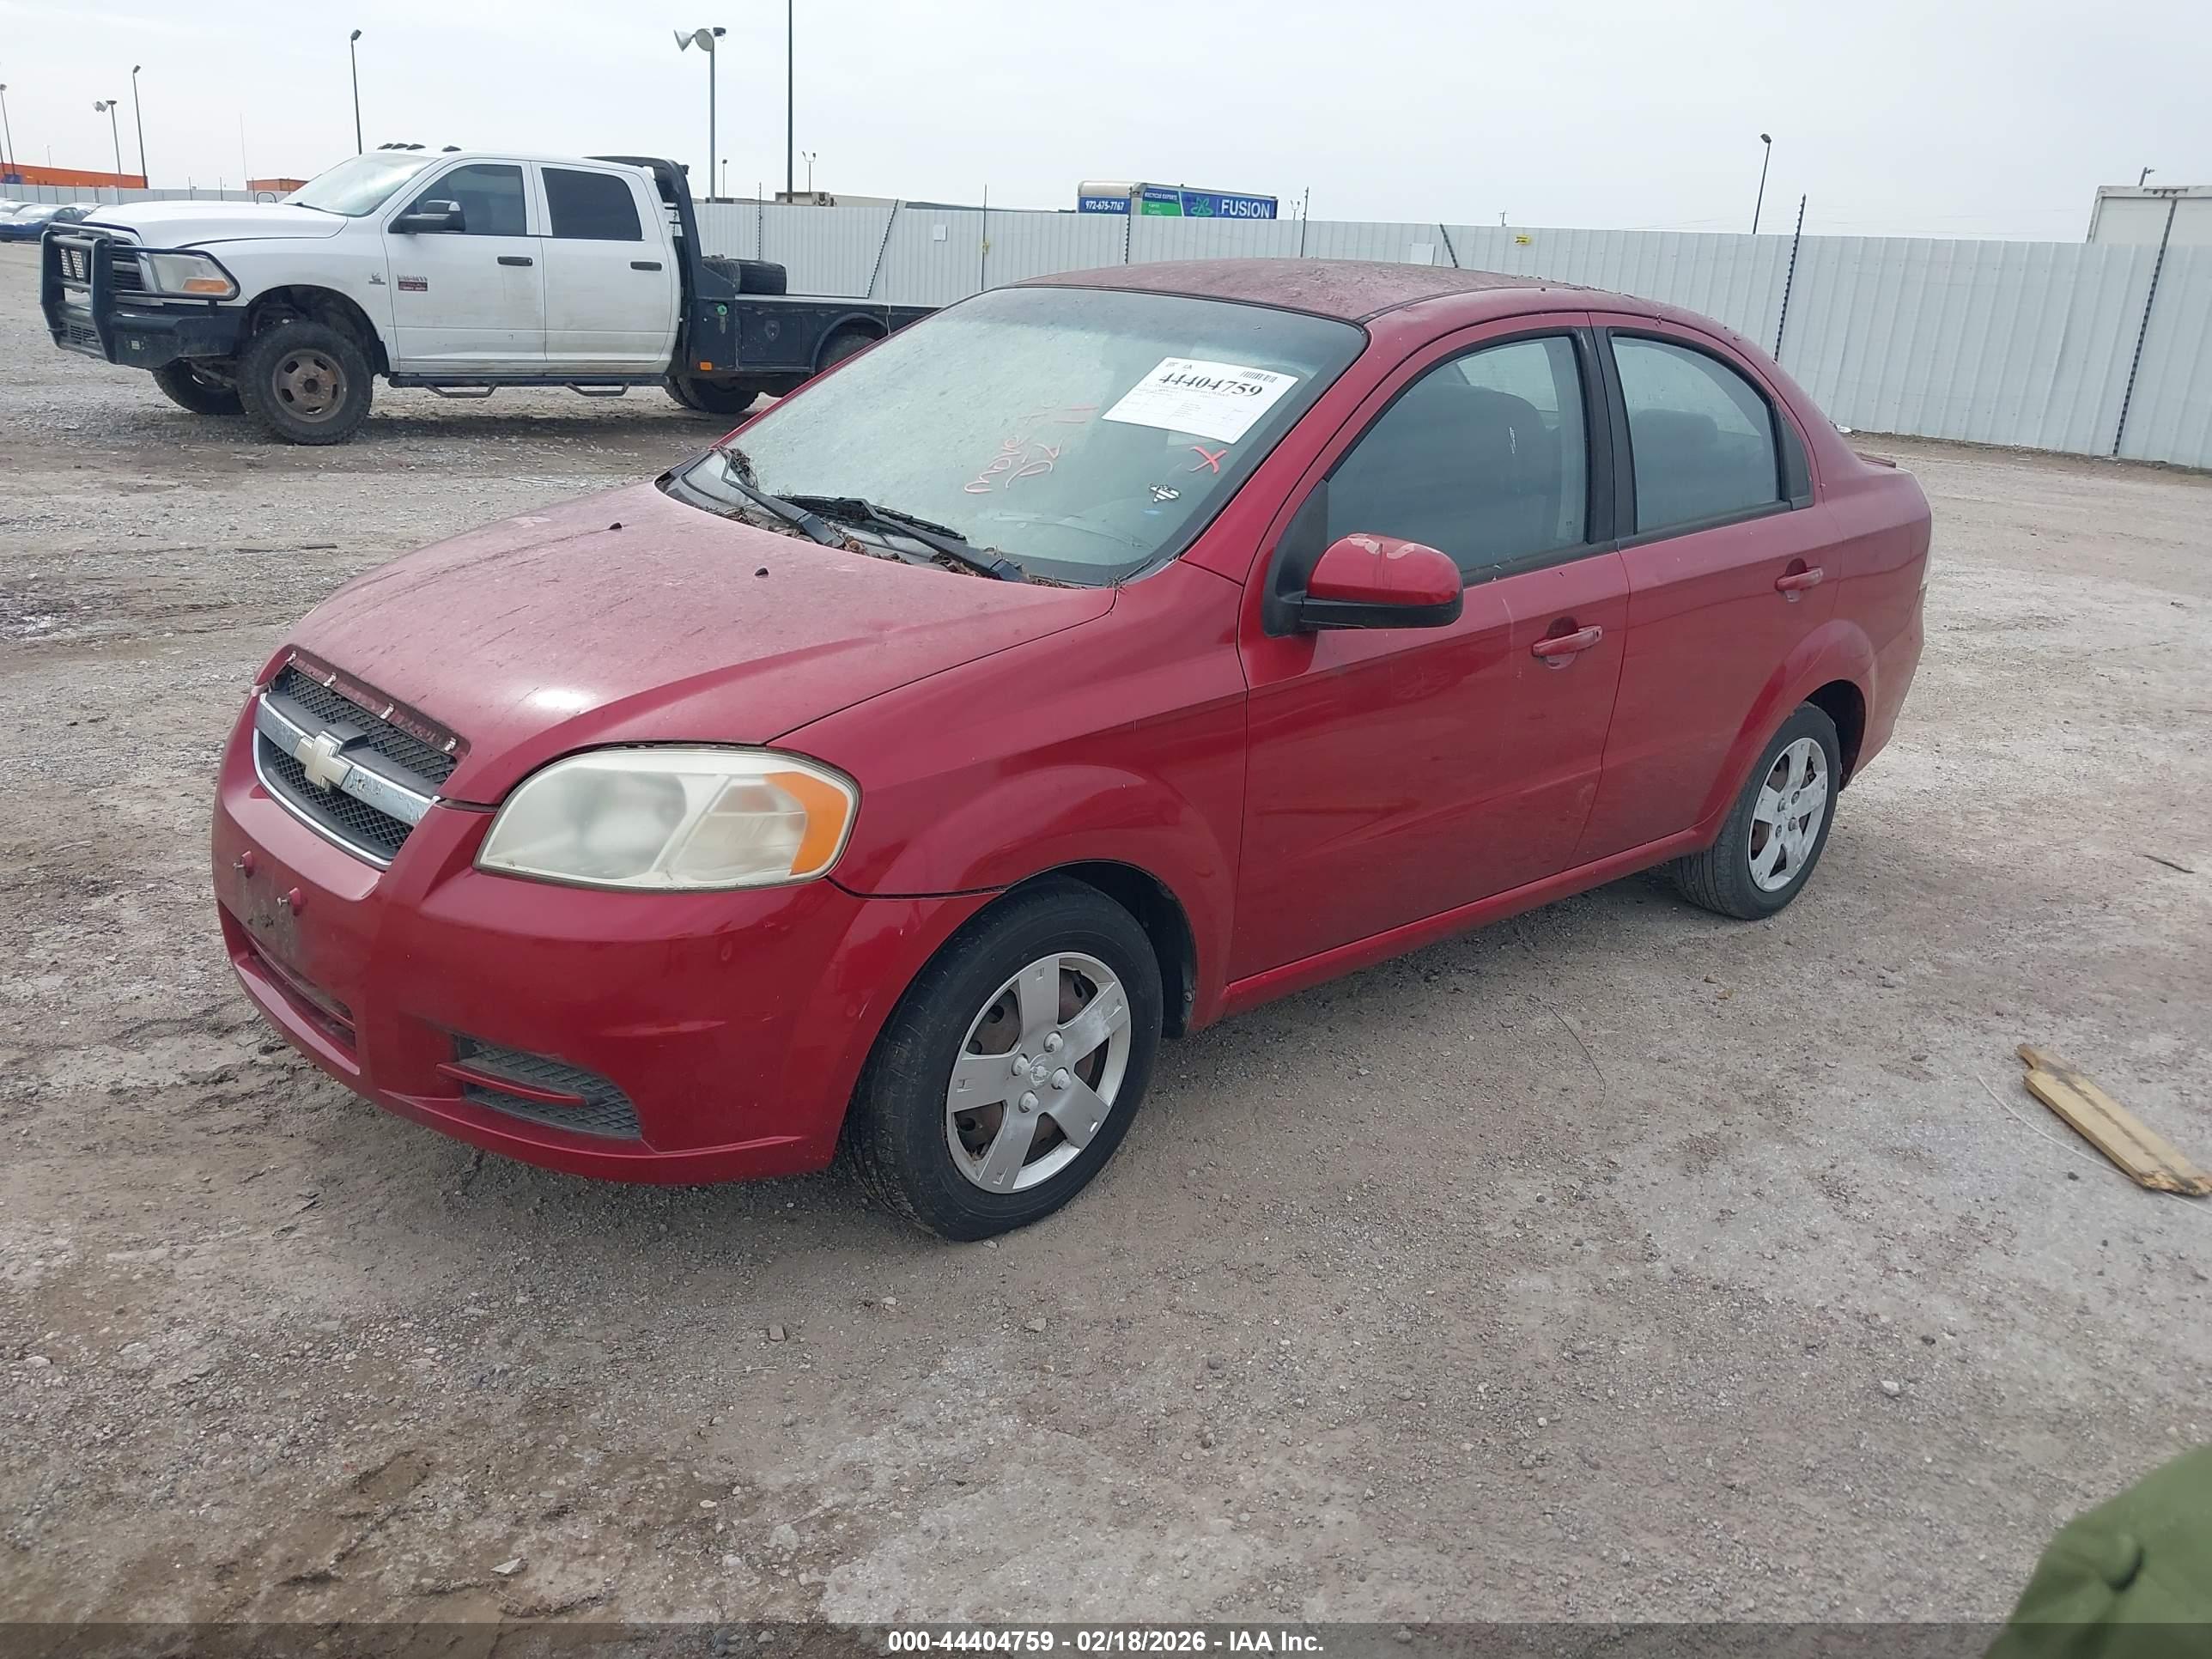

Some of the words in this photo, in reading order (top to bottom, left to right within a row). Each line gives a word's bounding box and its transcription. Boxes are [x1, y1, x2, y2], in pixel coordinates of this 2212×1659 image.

[1085, 200, 1125, 211] 972-675-7767
[1221, 198, 1270, 219] FUSION
[1159, 372, 1263, 397] 44404759
